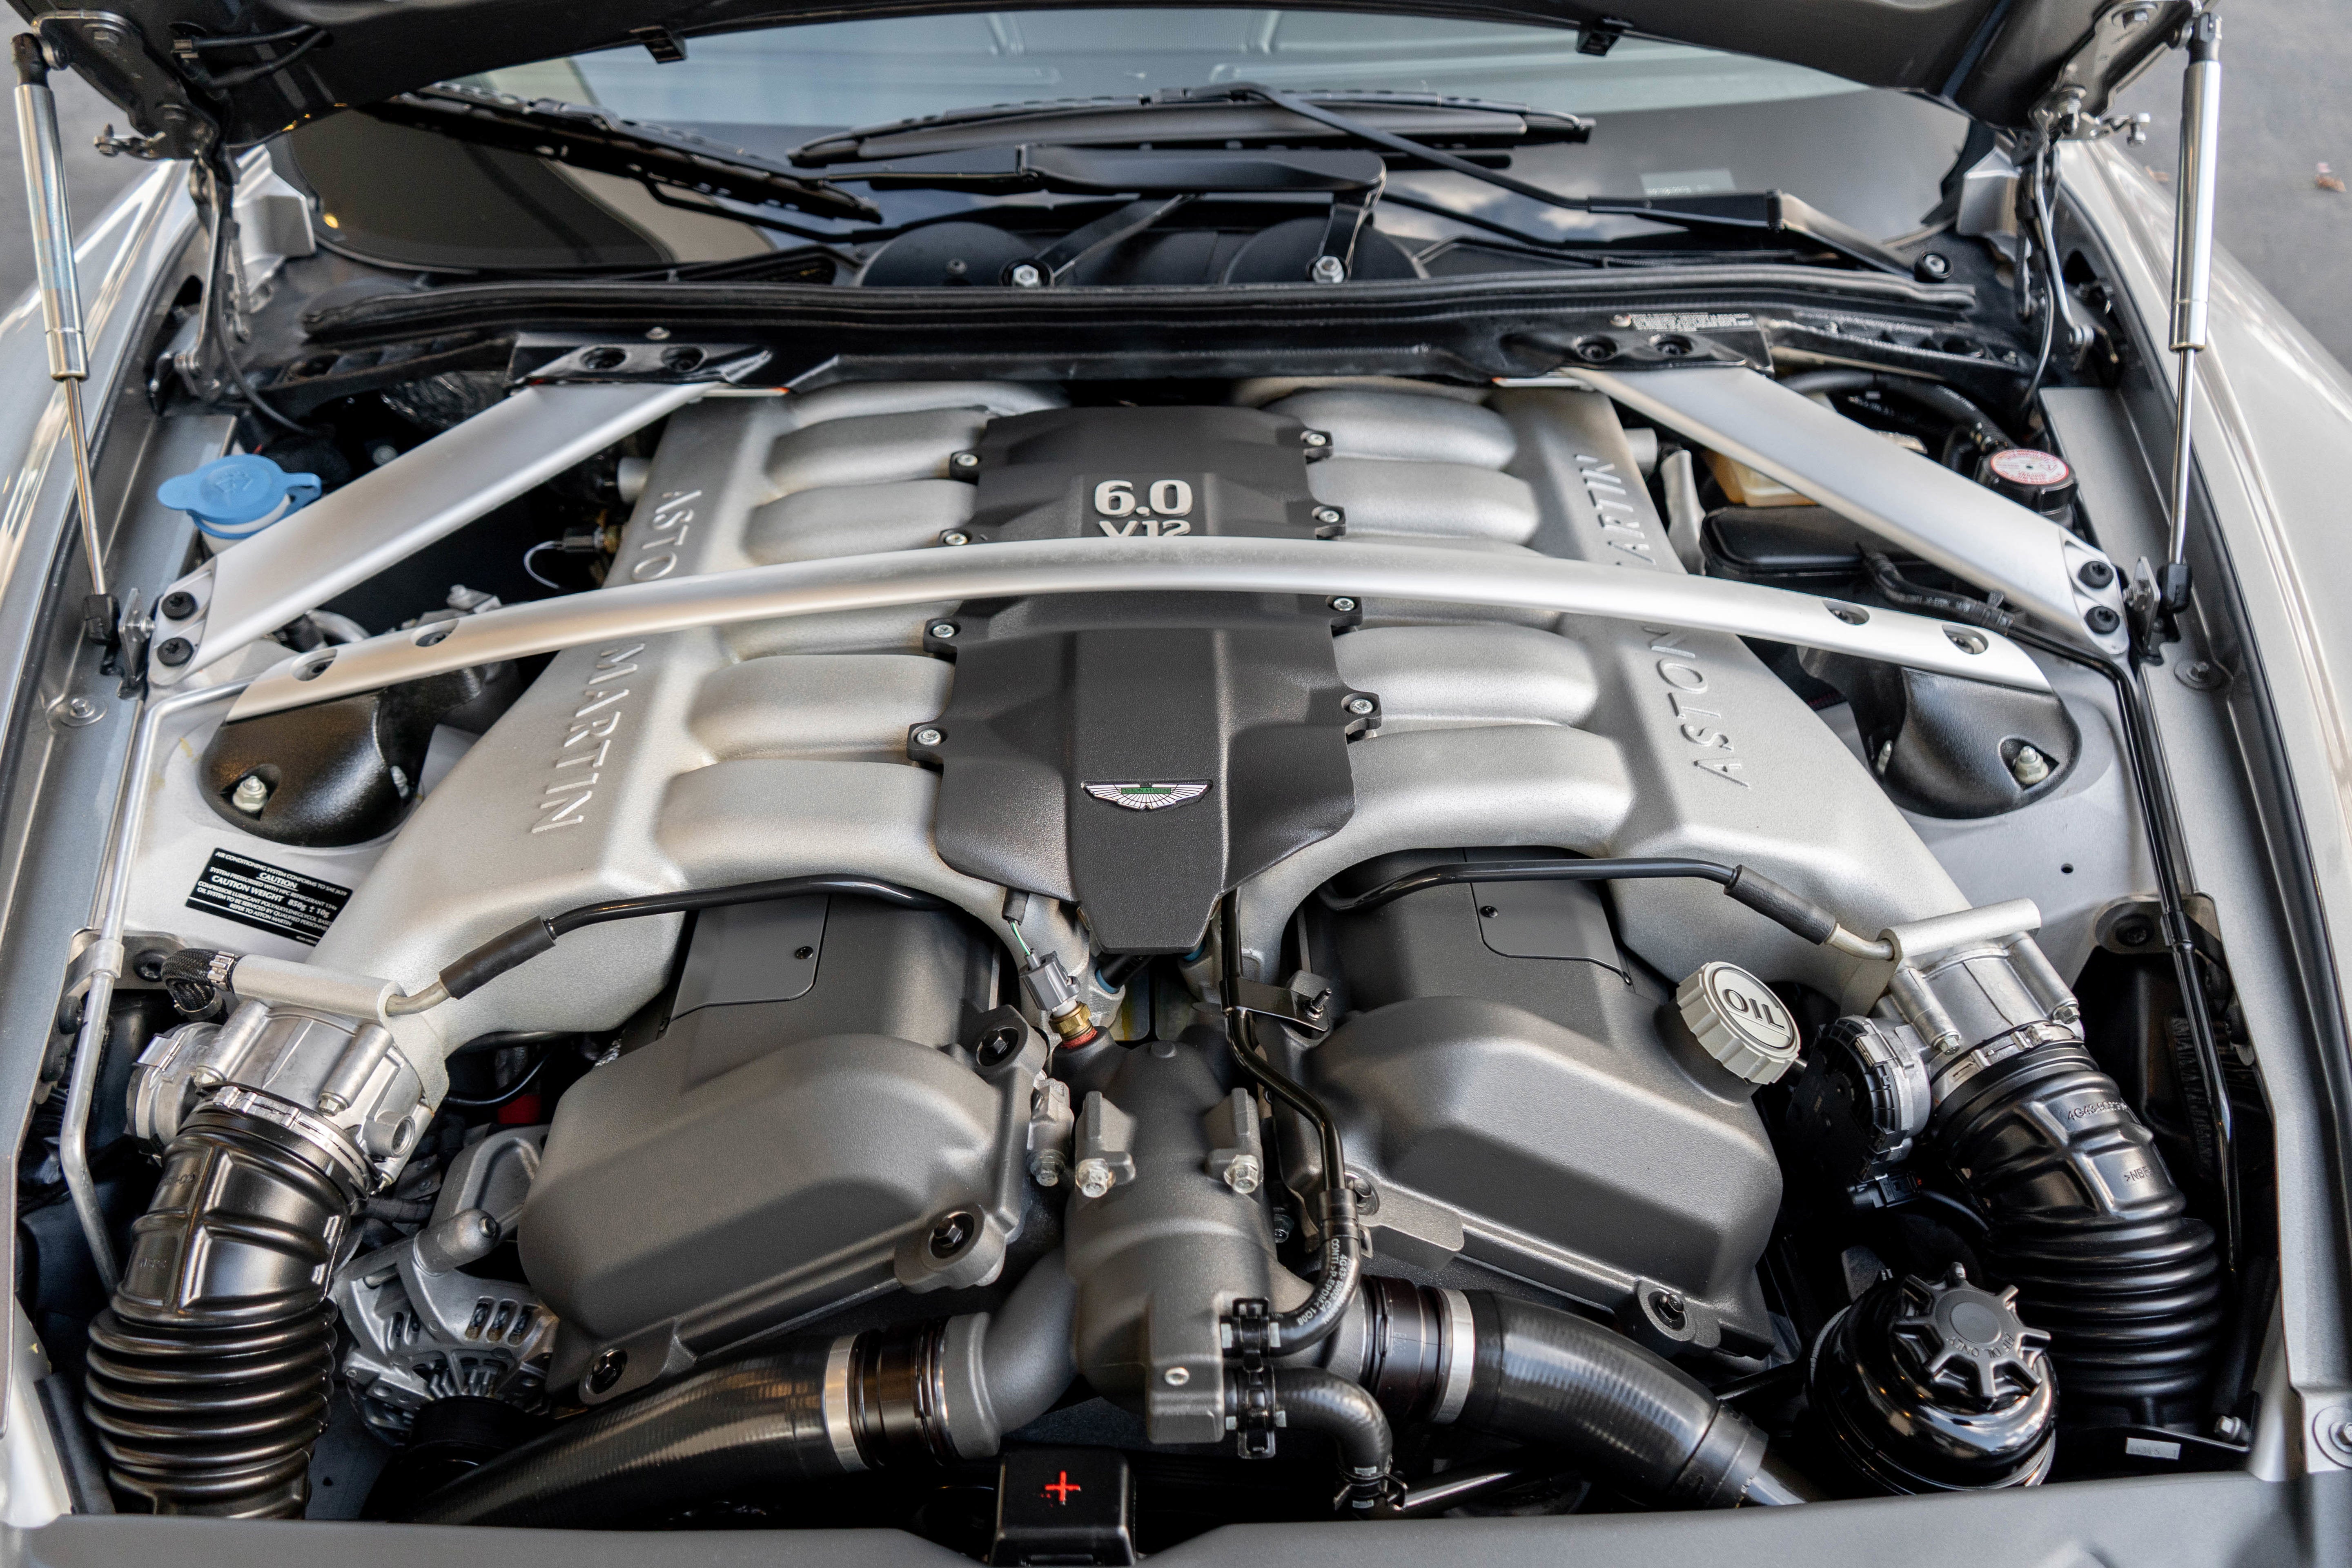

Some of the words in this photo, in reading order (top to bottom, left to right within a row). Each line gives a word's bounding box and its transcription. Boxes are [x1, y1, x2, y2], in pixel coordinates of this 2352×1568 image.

[1094, 479, 1193, 517] 6.0
[1574, 454, 1657, 566] ARTIN
[632, 490, 702, 582] ASTO
[1098, 519, 1192, 537] V12
[531, 643, 646, 833] MARTIN
[209, 867, 230, 877] SYSTEM
[264, 884, 278, 892] WITH
[290, 892, 325, 906] REFRIGERANT
[225, 855, 267, 871] CONDITIONING
[266, 867, 287, 877] SYSTEM
[287, 874, 317, 886] CONFORMS
[258, 873, 297, 888] CAUTION
[198, 881, 232, 895] COMPRESSOR
[232, 891, 261, 904] LUBRICANT
[206, 890, 227, 900] SYSTEM
[241, 901, 266, 911] SERVICED
[273, 911, 300, 922] QUALIFIED
[212, 875, 251, 892] CAUTION
[251, 887, 284, 902] WEIGHT
[288, 900, 307, 911] 850g
[317, 909, 329, 918] 10g
[229, 903, 246, 911] REFER
[253, 911, 272, 919] ASTON
[272, 917, 292, 926] MARTIN
[1722, 989, 1785, 1031] OIL
[1331, 1238, 1340, 1263] CONTI
